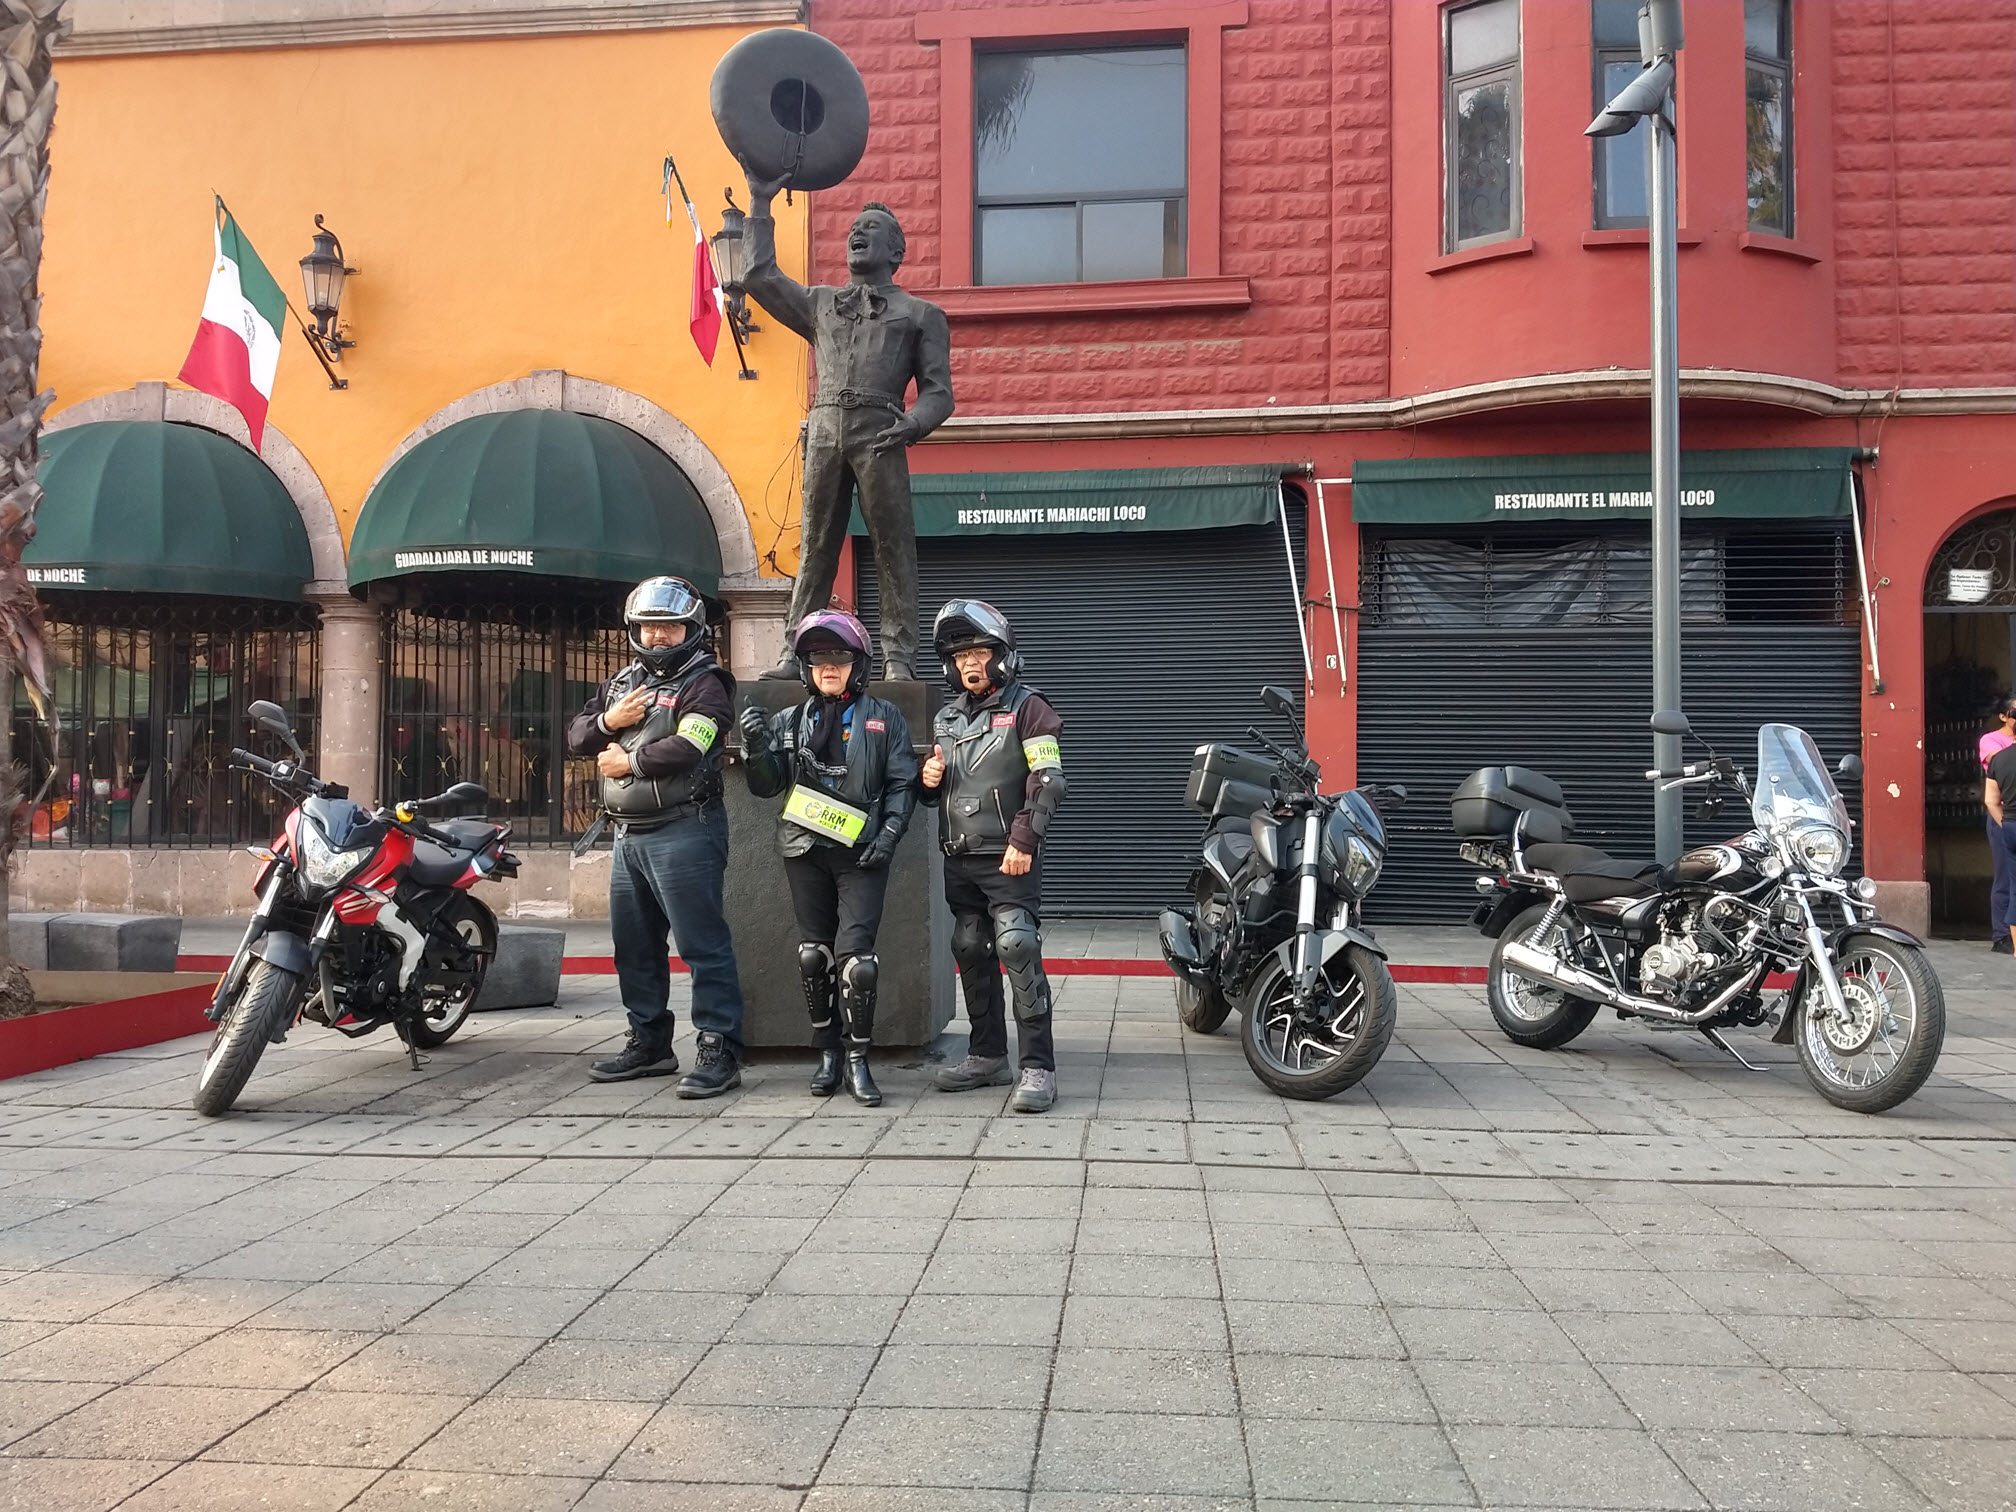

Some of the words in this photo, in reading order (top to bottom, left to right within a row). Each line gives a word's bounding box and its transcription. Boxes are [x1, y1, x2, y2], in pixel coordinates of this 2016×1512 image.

[1495, 493, 1589, 510] RESTAURANTE
[1591, 492, 1606, 508] EL
[1608, 491, 1654, 507] MARIA
[1680, 490, 1715, 506] LOCO
[958, 508, 1044, 524] RESTAURANTE
[1047, 507, 1110, 523] MARIACHI
[1113, 505, 1146, 521] LOCO
[395, 550, 471, 568] GUADALAJARA
[472, 550, 488, 564] DE
[490, 550, 534, 566] NOCHE
[26, 568, 42, 582] DE
[43, 568, 86, 583] NOCHE
[1327, 656, 1336, 668] C
[691, 724, 713, 743] RRM
[821, 809, 847, 828] RRM
